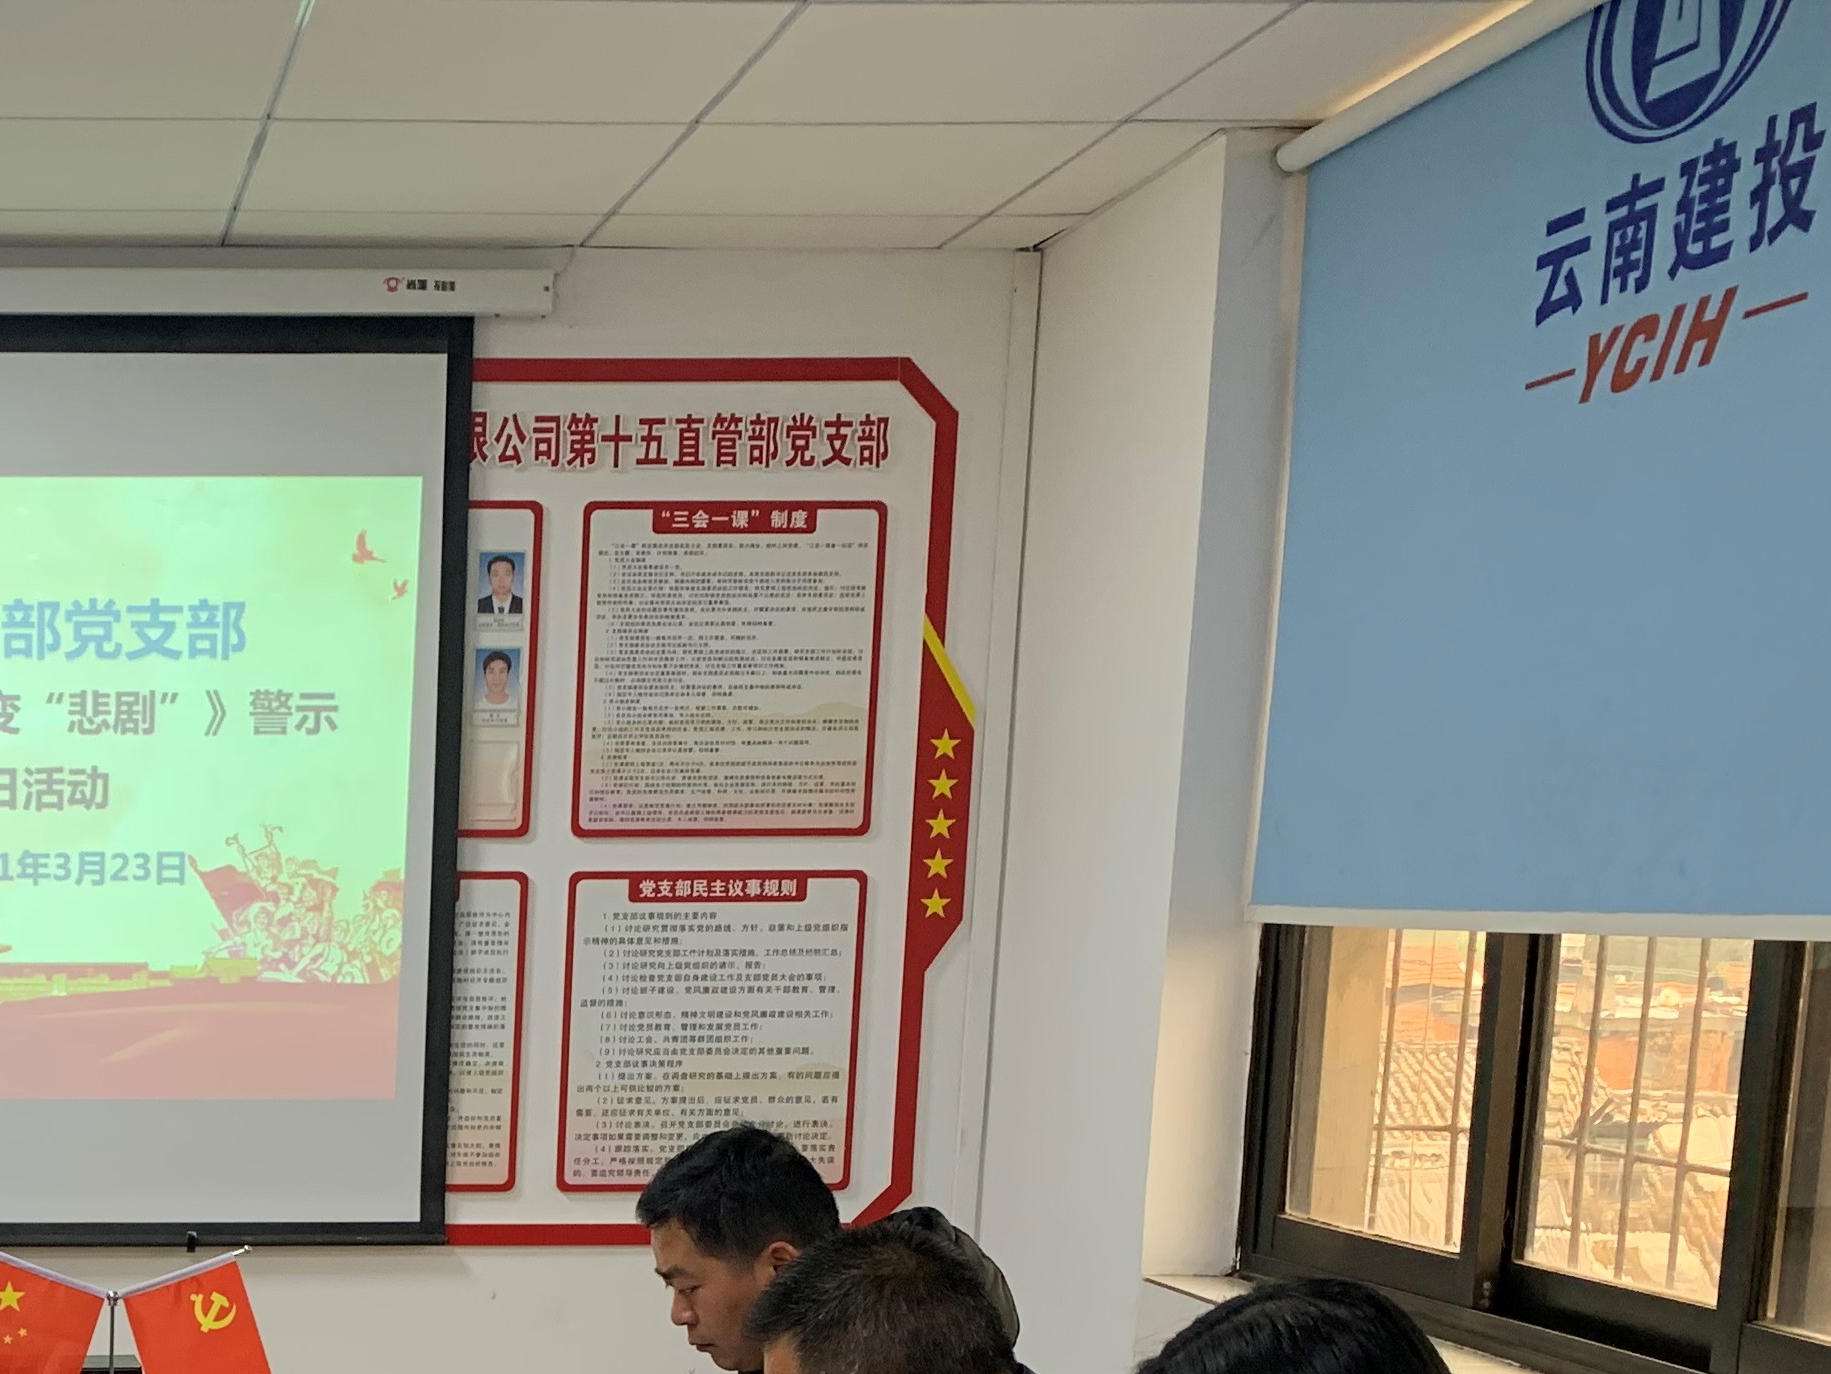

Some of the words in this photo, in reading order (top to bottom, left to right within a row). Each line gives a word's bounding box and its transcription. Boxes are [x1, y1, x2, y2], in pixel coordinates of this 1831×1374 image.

[1535, 102, 1826, 327] 云南建投
[1578, 285, 1739, 403] YCIH
[639, 879, 797, 897] 党支部民主议事规则
